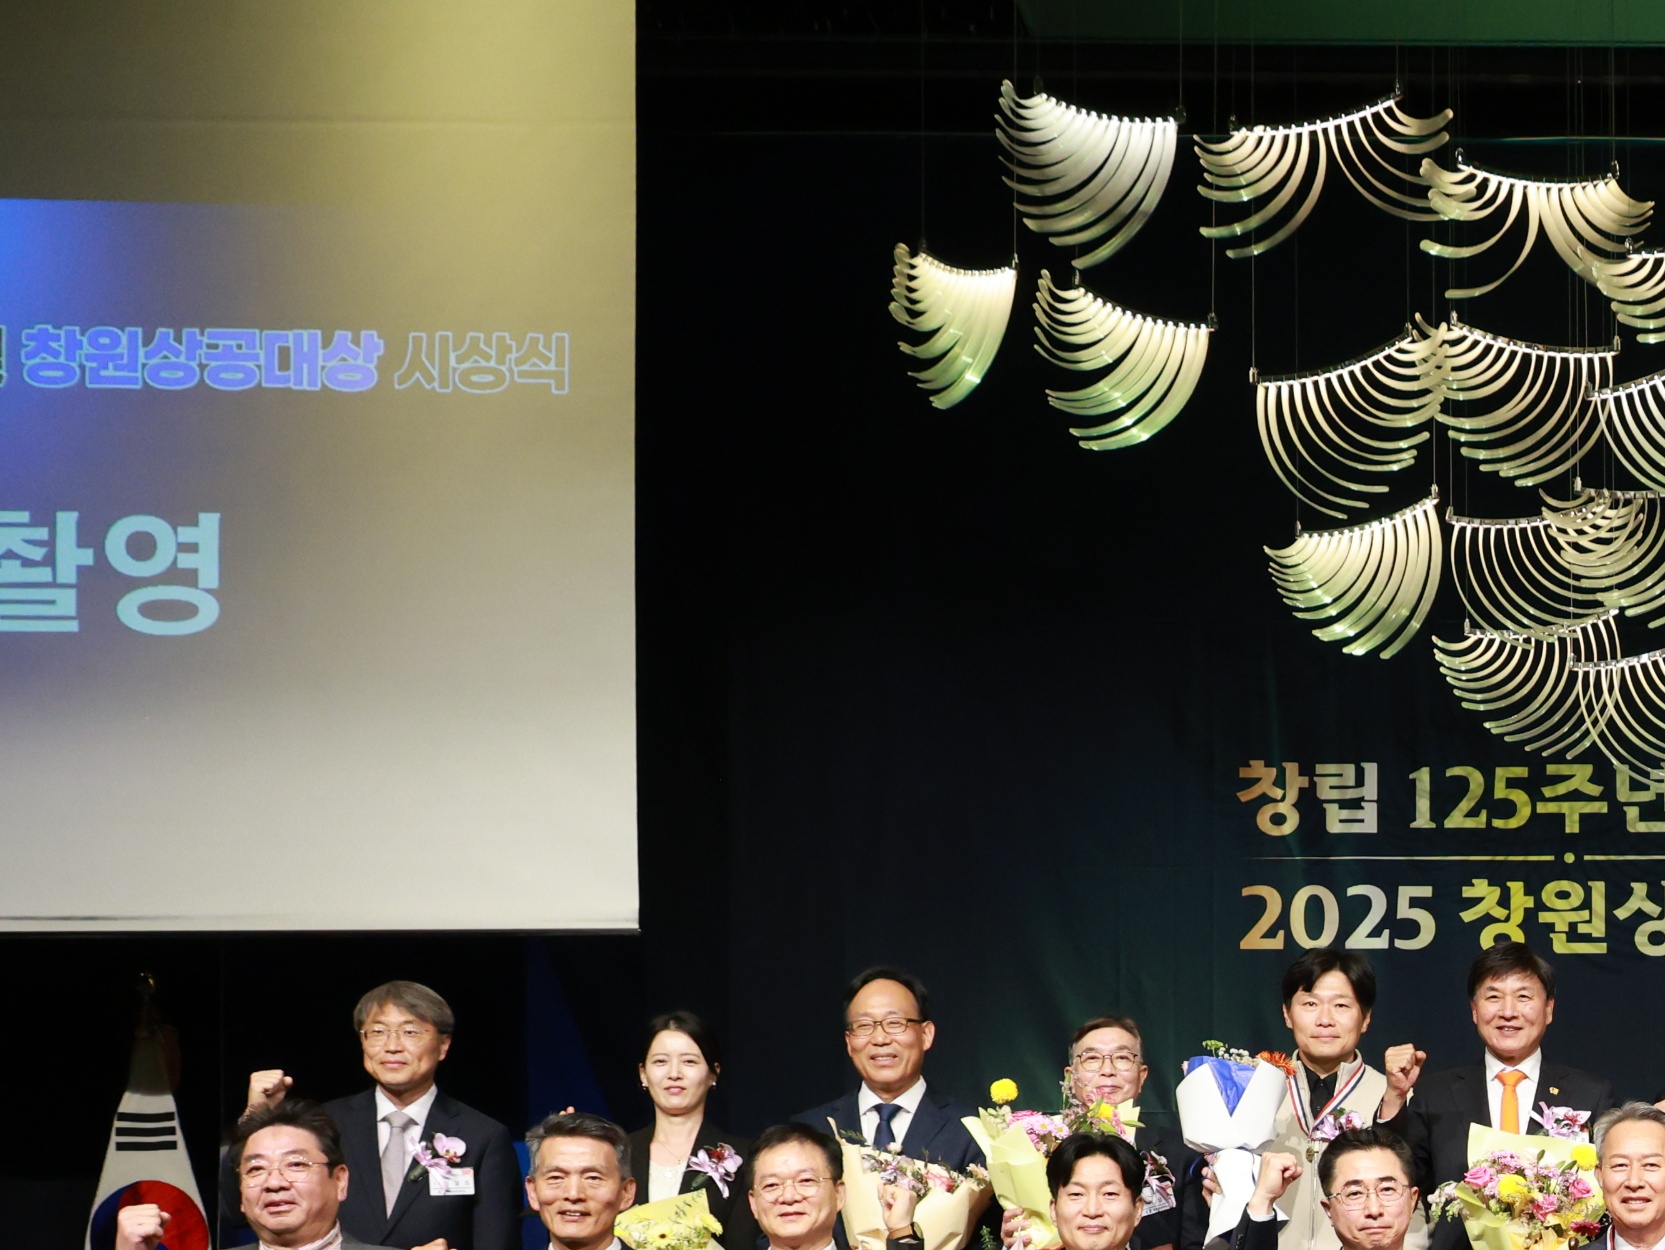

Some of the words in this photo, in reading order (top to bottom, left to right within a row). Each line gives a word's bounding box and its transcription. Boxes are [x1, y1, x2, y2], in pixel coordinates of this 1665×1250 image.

[21, 325, 383, 392] 창원상공대상
[394, 332, 569, 394] 시상식
[1237, 760, 1378, 837] 창립
[1239, 885, 1436, 950] 2025
